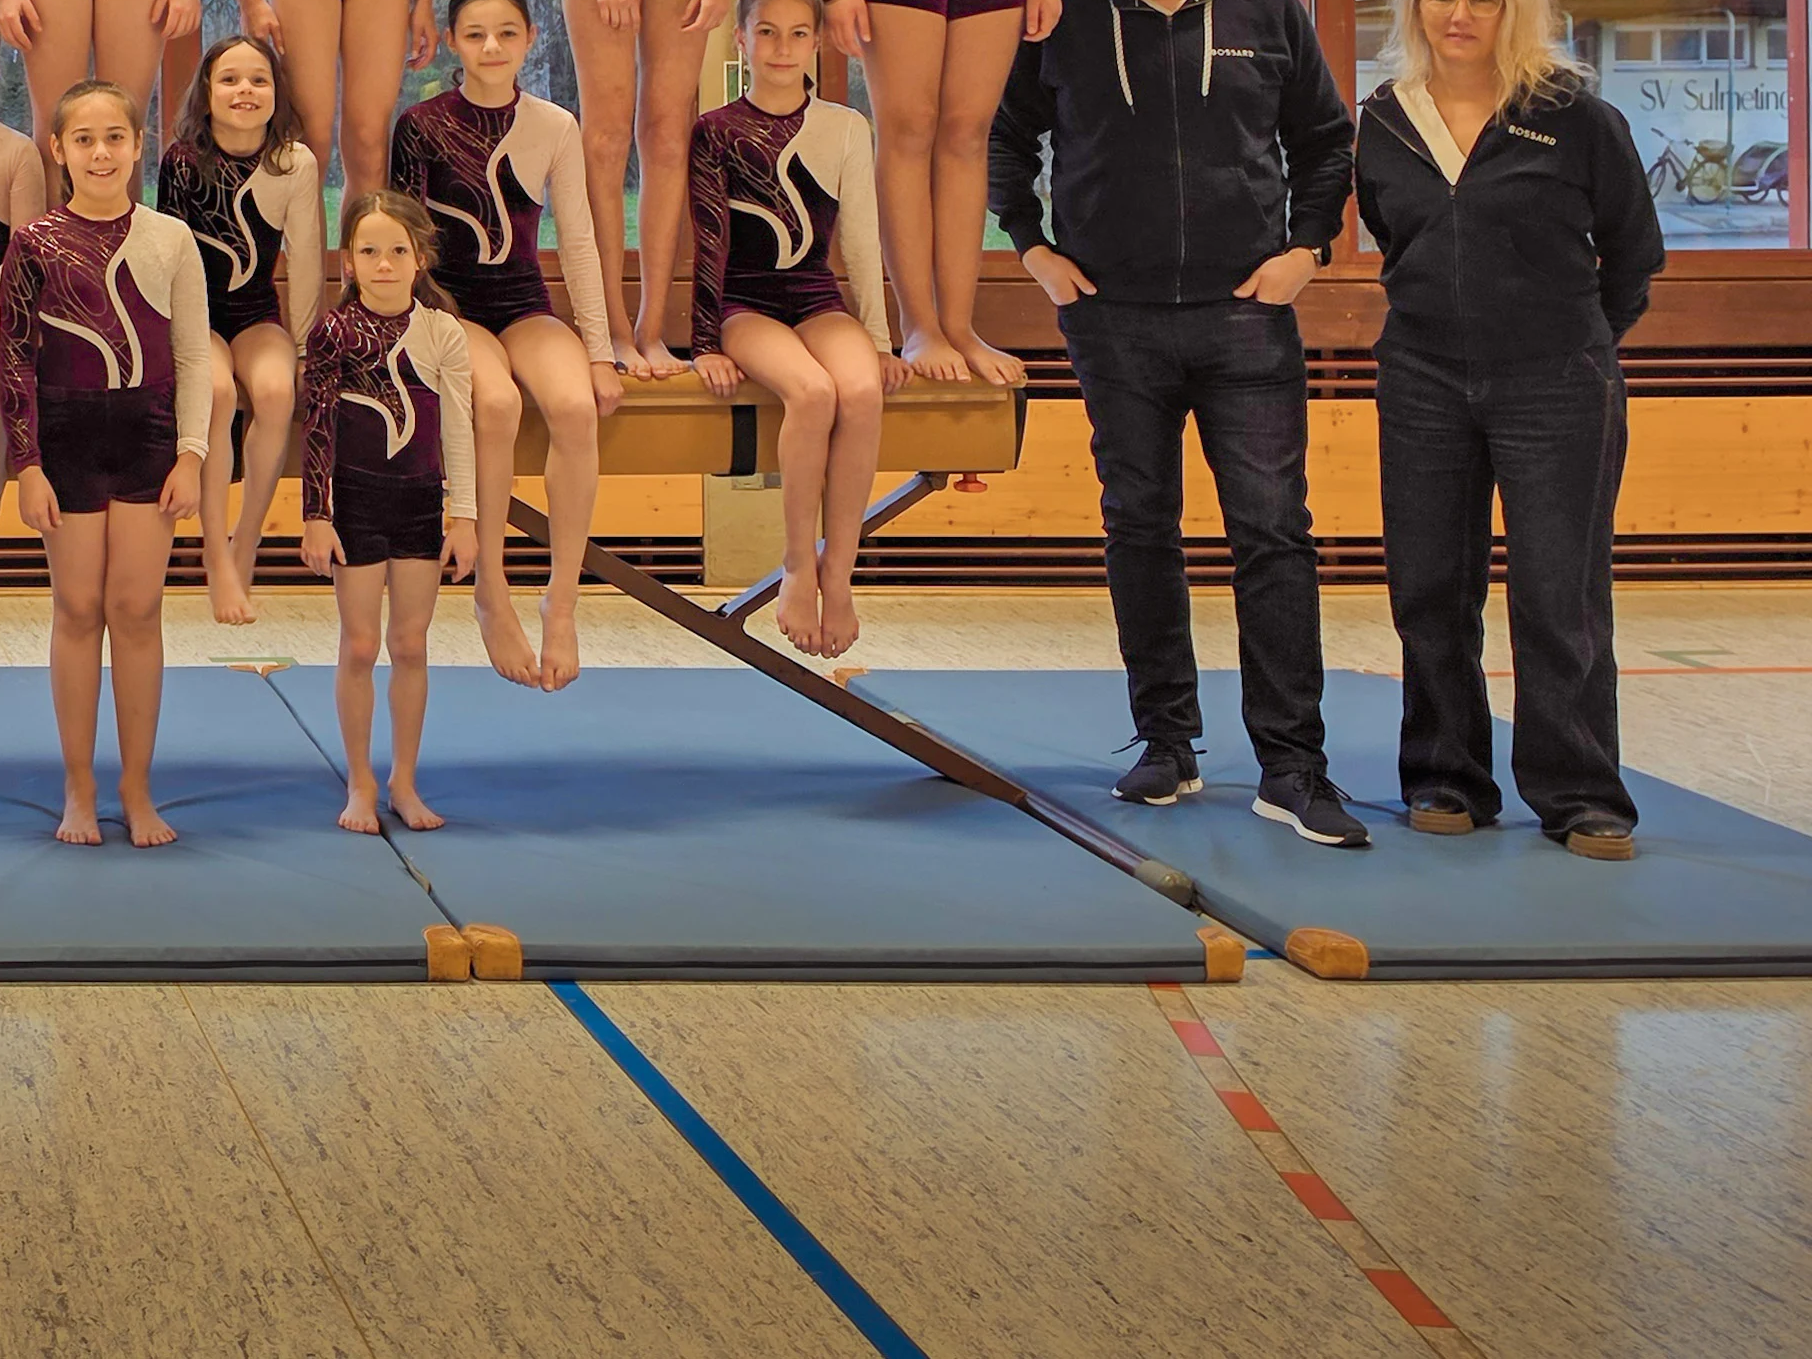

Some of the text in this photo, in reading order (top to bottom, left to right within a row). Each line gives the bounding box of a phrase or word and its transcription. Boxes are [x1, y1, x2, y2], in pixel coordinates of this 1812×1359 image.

[1211, 48, 1255, 58] BOSSARD
[1639, 79, 1673, 112] SV
[1508, 124, 1557, 146] BOSSARD
